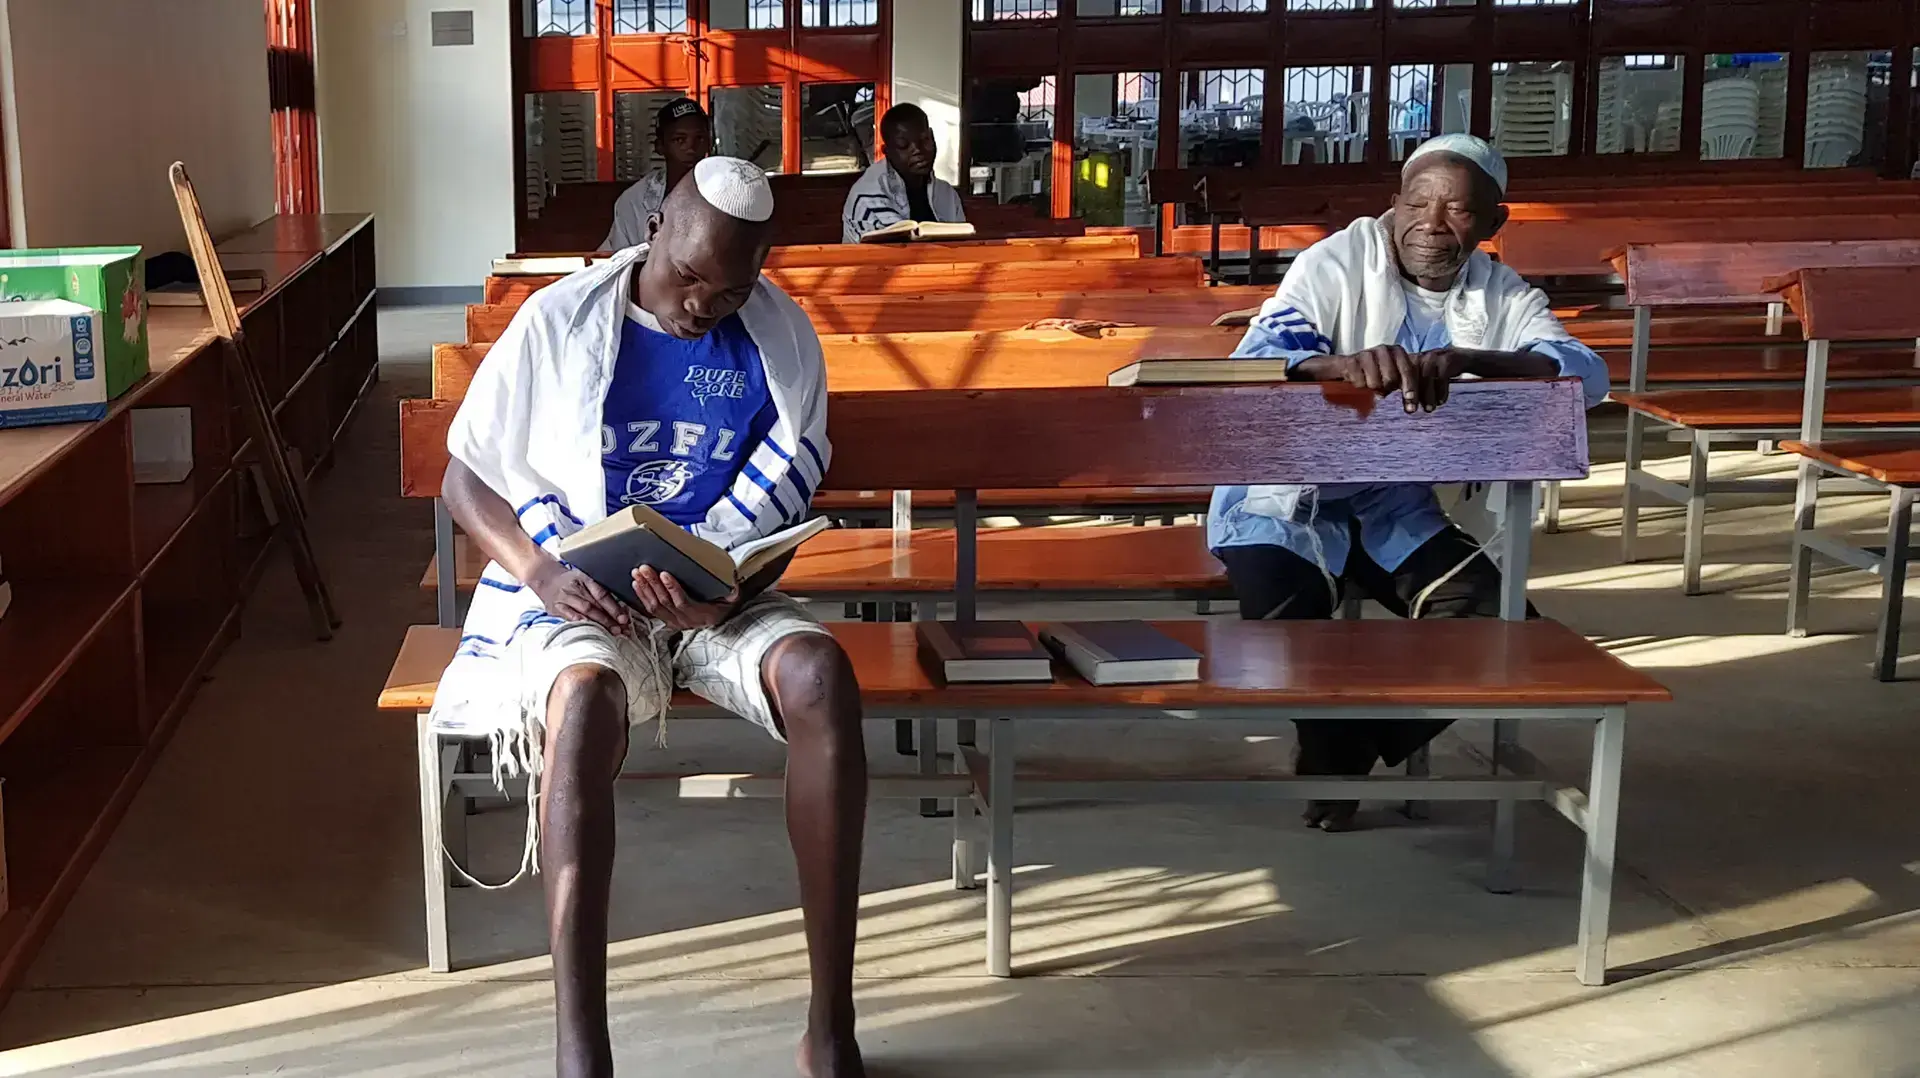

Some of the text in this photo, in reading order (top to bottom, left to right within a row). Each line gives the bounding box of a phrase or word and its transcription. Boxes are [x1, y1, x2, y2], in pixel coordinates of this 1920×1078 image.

[684, 365, 746, 383] DUBE
[25, 391, 52, 401] Water
[691, 381, 743, 399] ZONE
